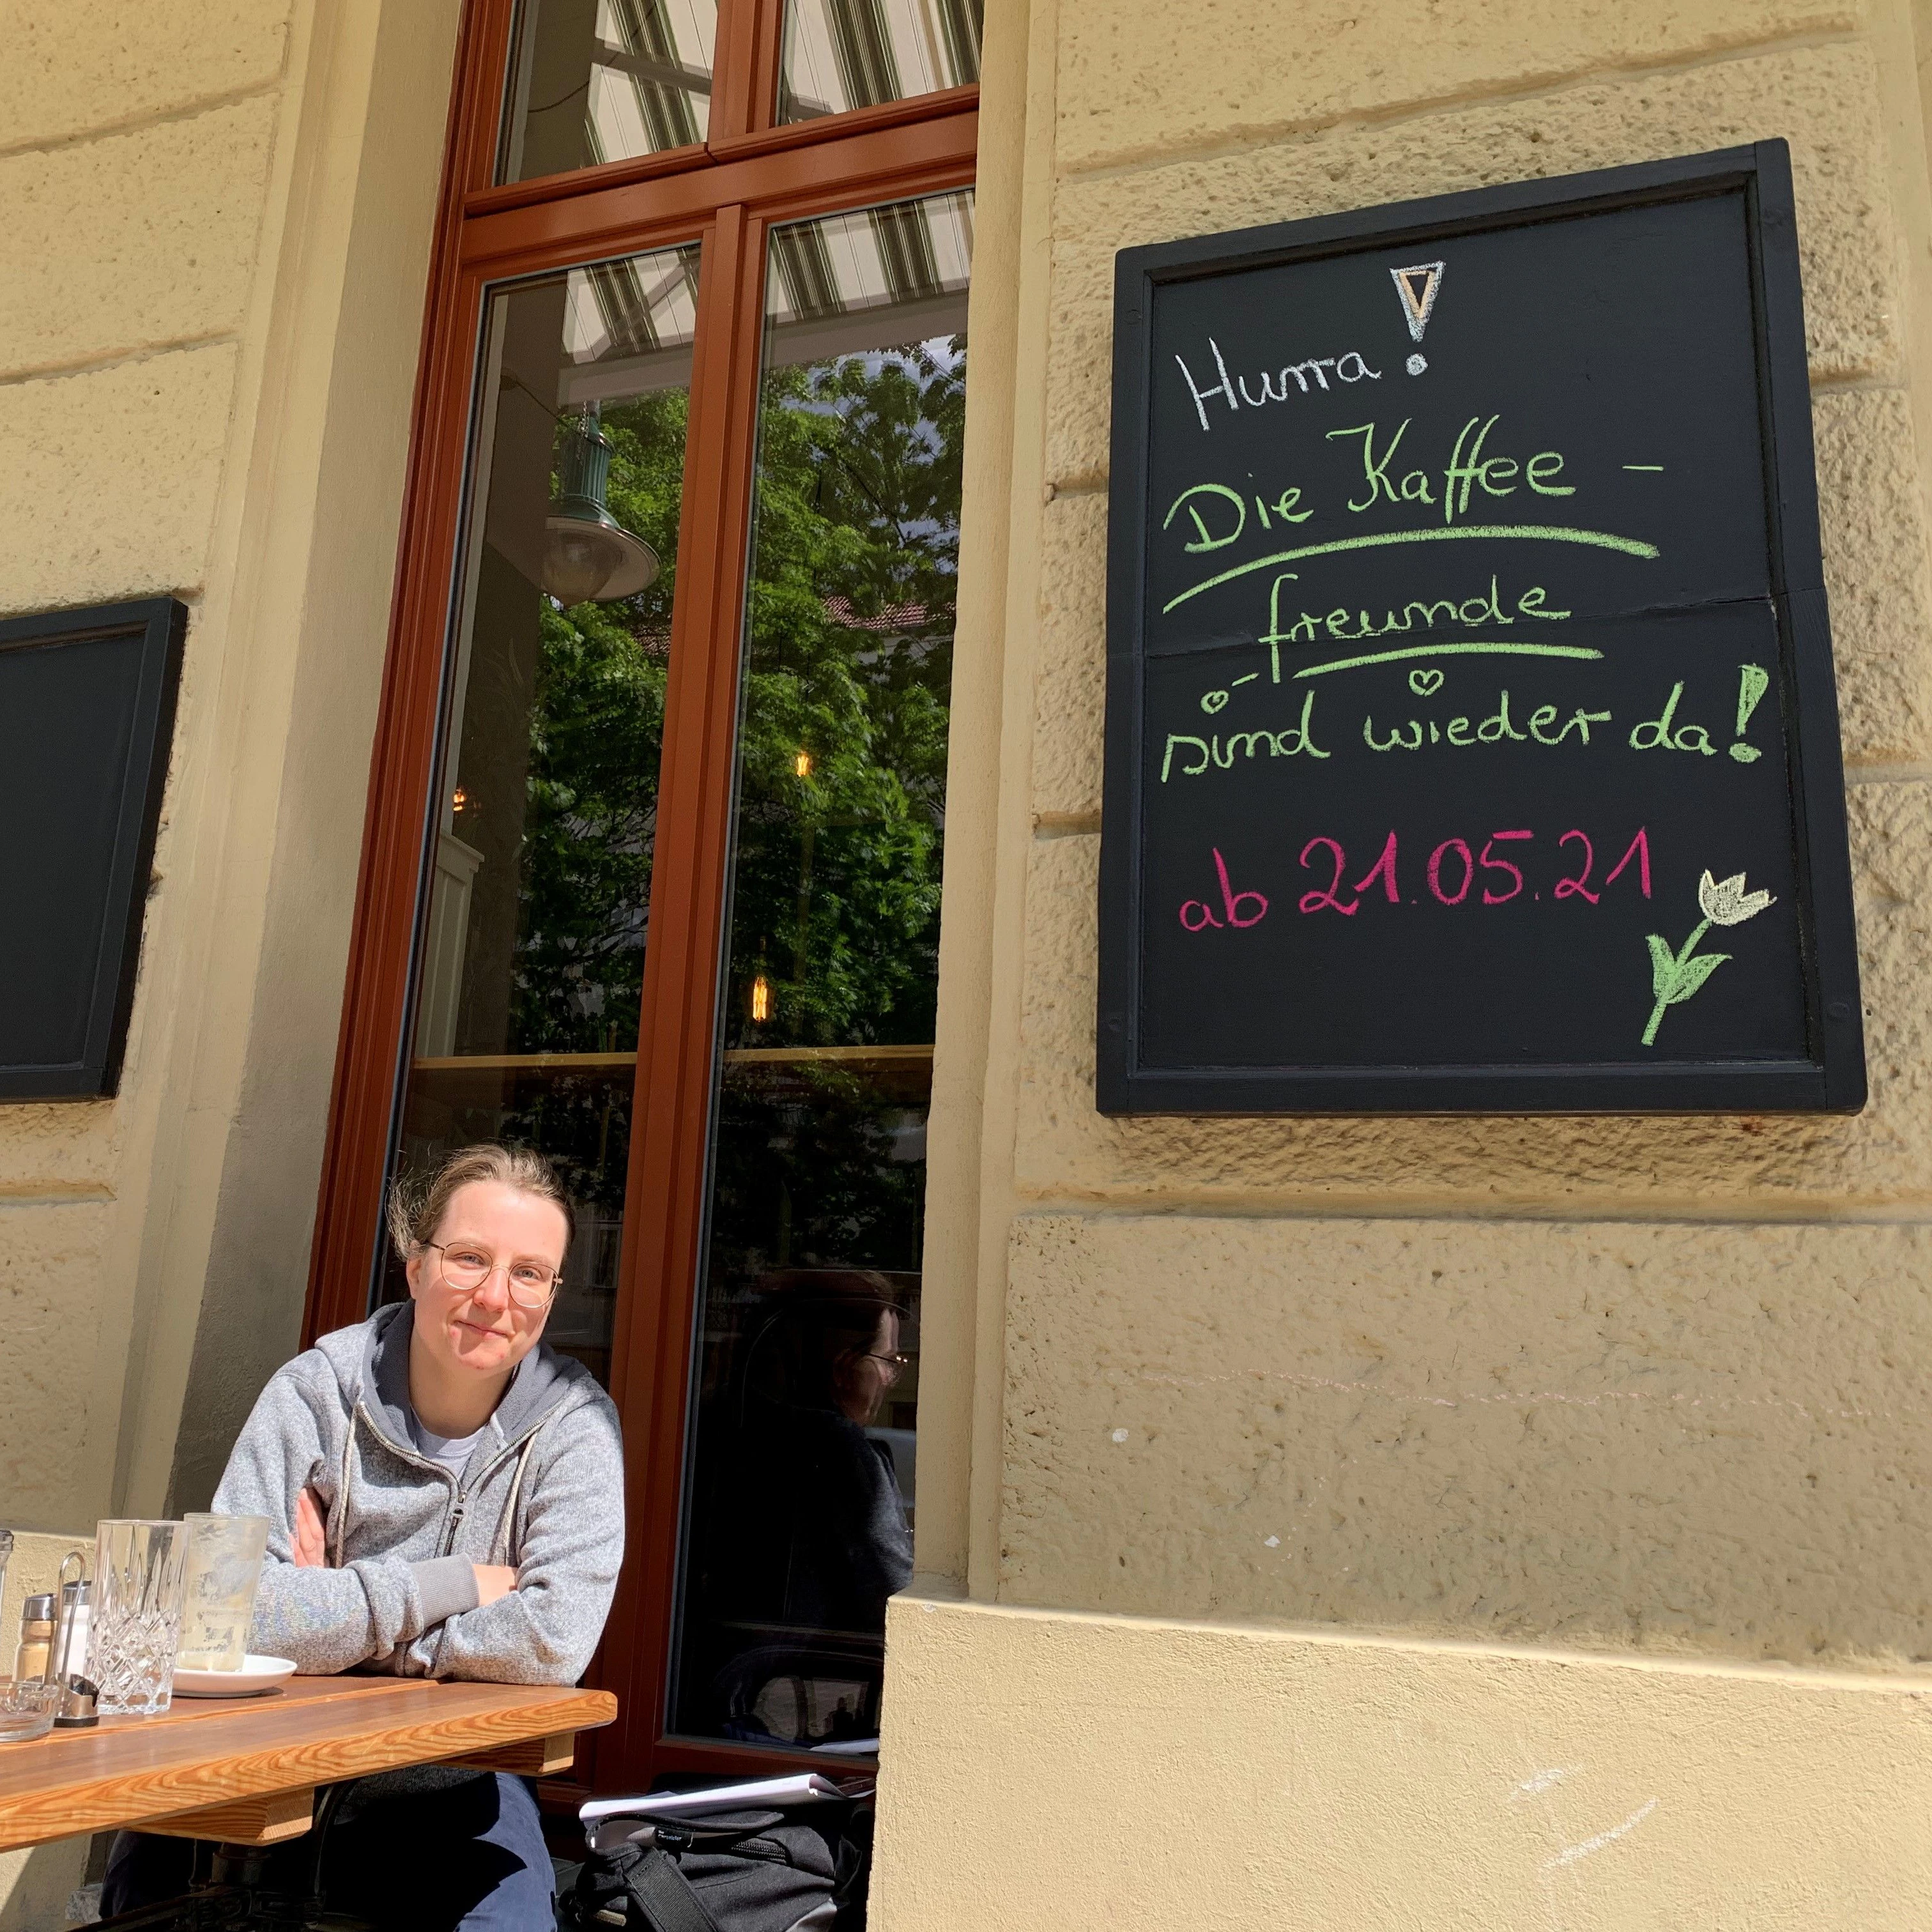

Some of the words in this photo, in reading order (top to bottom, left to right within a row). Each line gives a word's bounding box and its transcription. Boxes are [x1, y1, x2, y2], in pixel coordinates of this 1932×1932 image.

[1163, 473, 1314, 553] Die
[1161, 689, 1331, 783] sind
[1363, 670, 1612, 751] wieder
[1628, 663, 1769, 763] da!
[1179, 848, 1268, 931] ab
[1299, 827, 1651, 916] 21.05.21
